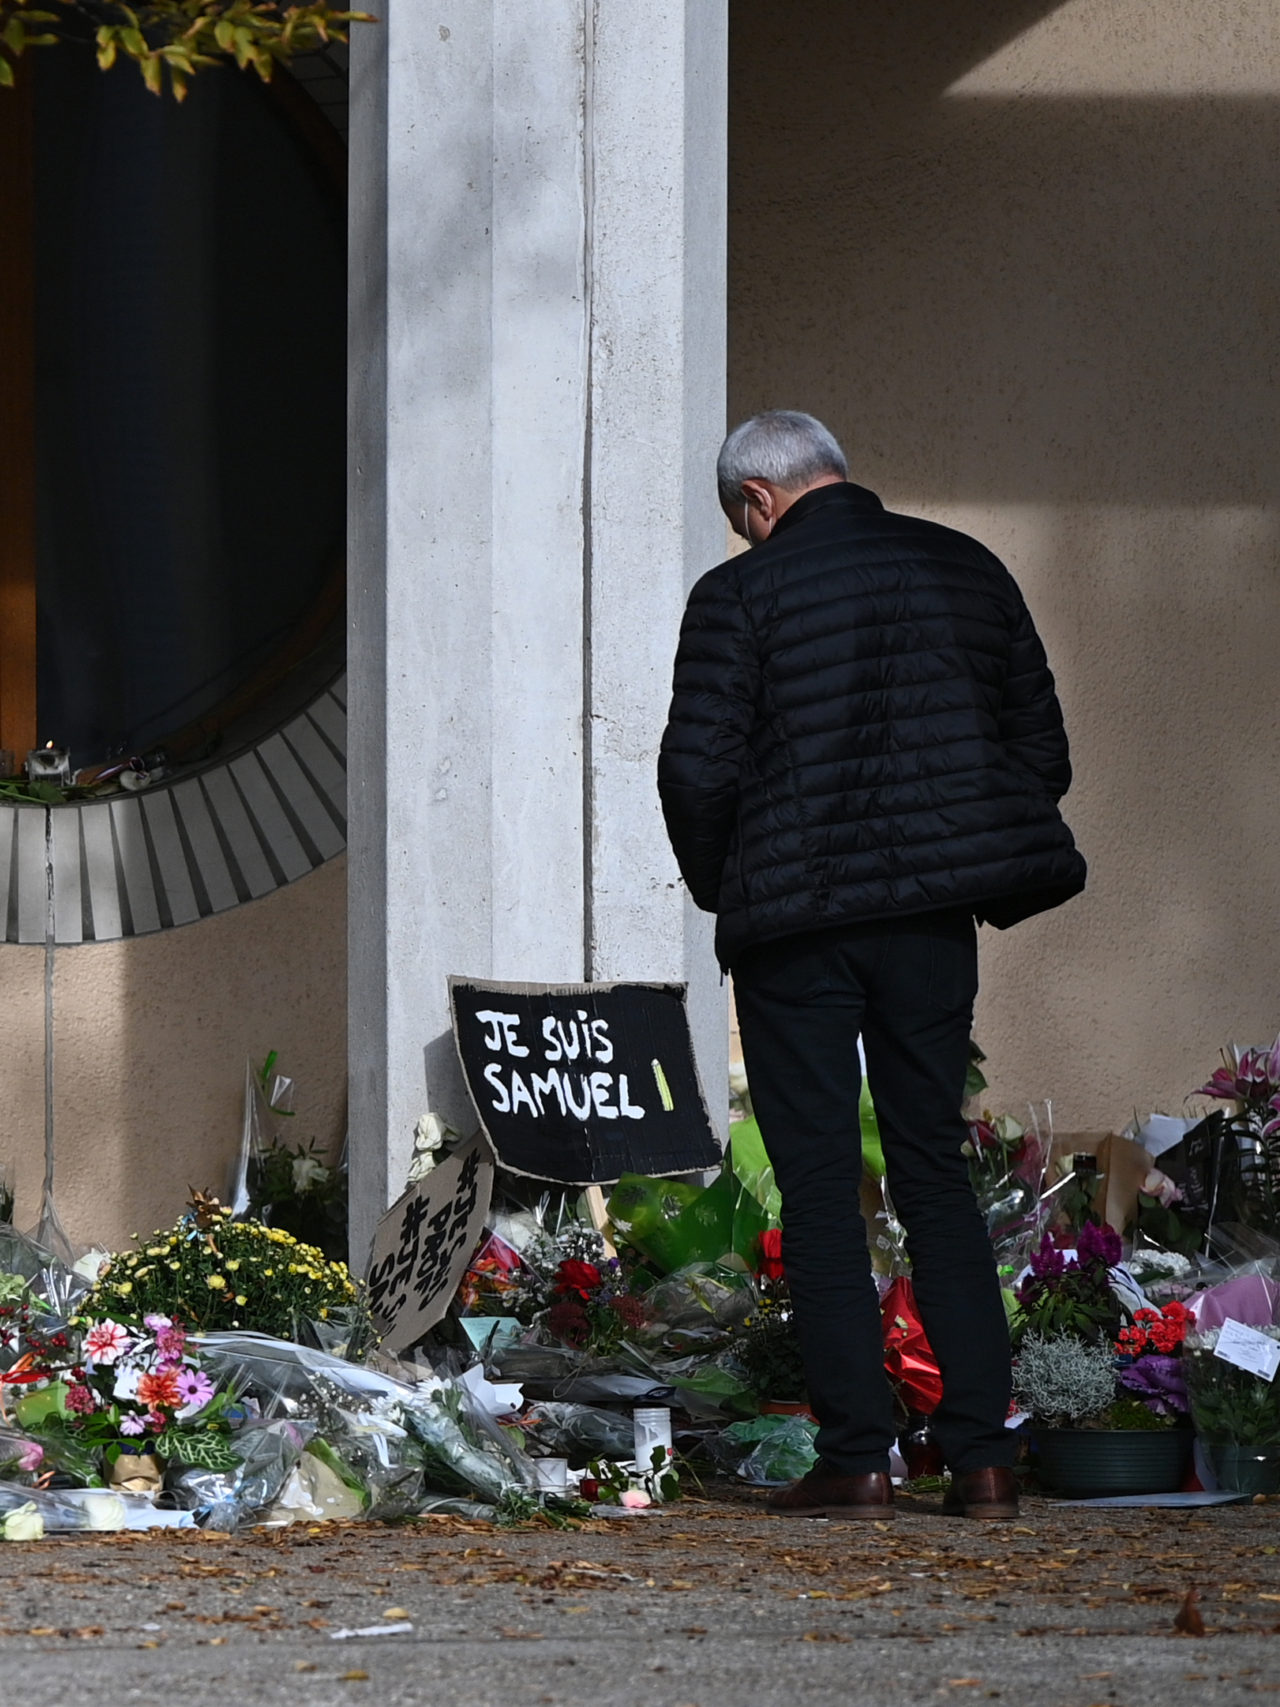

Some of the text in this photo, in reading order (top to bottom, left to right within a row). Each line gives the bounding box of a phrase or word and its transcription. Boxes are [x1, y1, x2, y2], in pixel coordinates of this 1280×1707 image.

[475, 1009, 530, 1058] JE
[483, 1062, 646, 1121] SAMUEL
[448, 1147, 481, 1242] #JE
[388, 1194, 431, 1297] #JE
[413, 1199, 454, 1296] PROF
